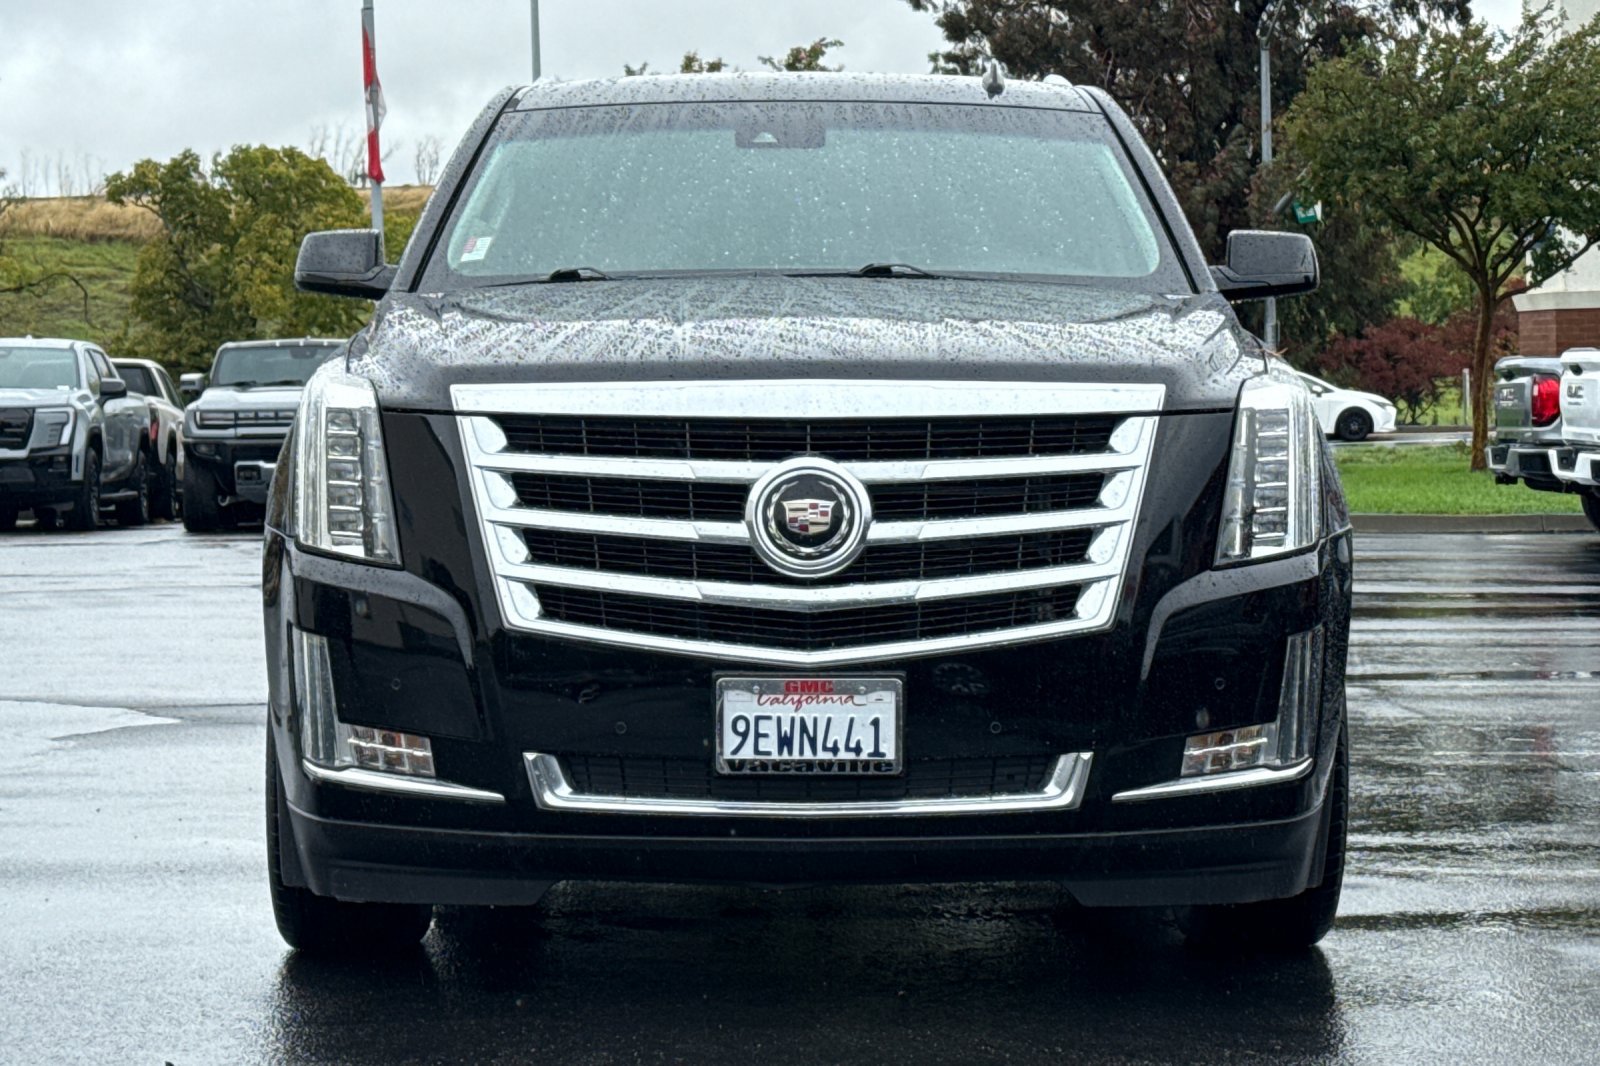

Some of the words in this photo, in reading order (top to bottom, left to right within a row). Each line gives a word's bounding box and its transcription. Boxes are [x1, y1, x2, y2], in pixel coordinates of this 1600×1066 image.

[784, 680, 834, 693] GMC
[756, 693, 867, 712] California
[730, 714, 887, 757] 9EWN441
